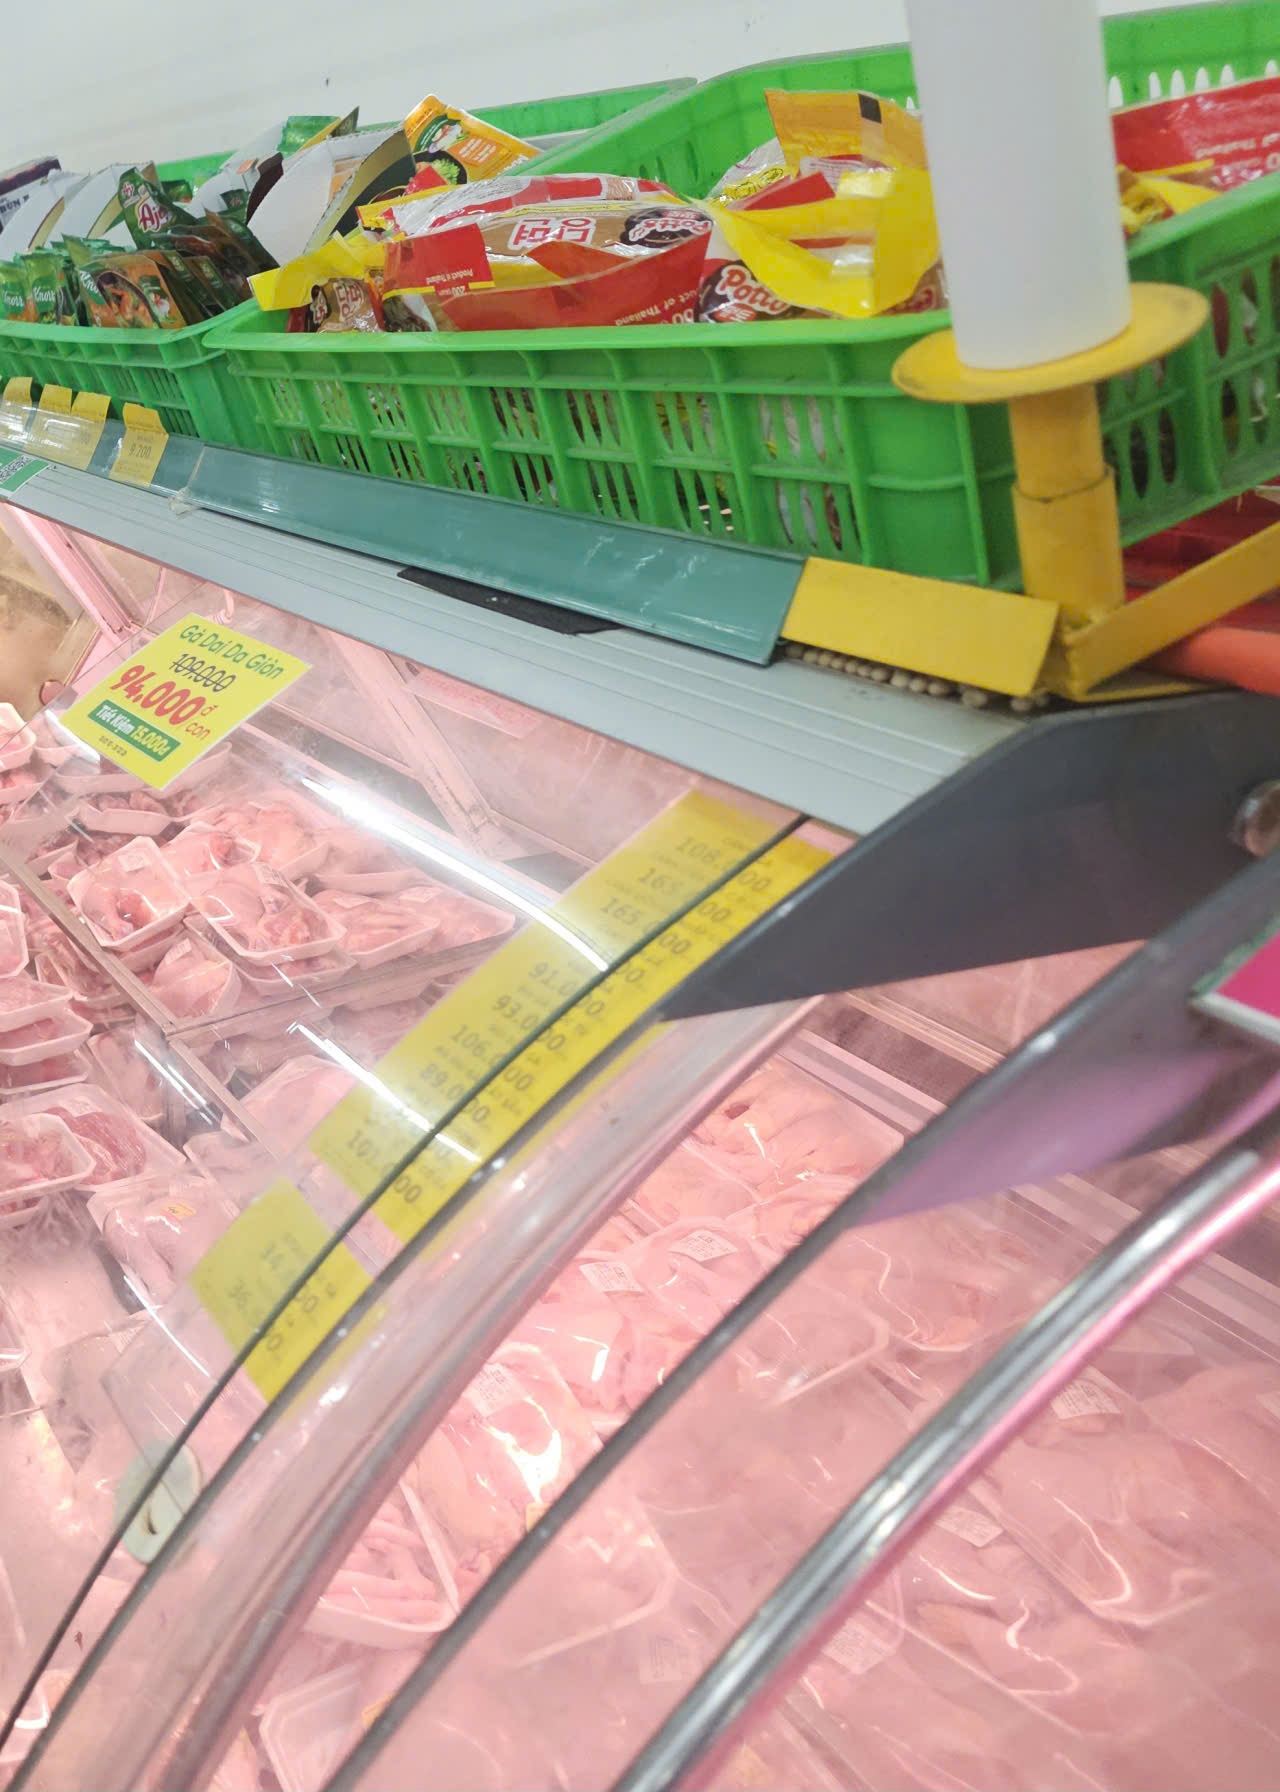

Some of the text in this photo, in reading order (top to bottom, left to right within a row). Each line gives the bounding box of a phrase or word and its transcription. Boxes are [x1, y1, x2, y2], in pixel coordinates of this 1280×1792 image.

[33, 286, 56, 302] Knorr
[80, 270, 100, 296] Kno
[179, 625, 284, 679] Gà Dai Da Giòn
[168, 653, 236, 693] 109.000
[110, 664, 207, 725] 94.000
[96, 704, 115, 725] Tiết
[110, 712, 136, 735] Kiệm
[184, 722, 211, 741] con
